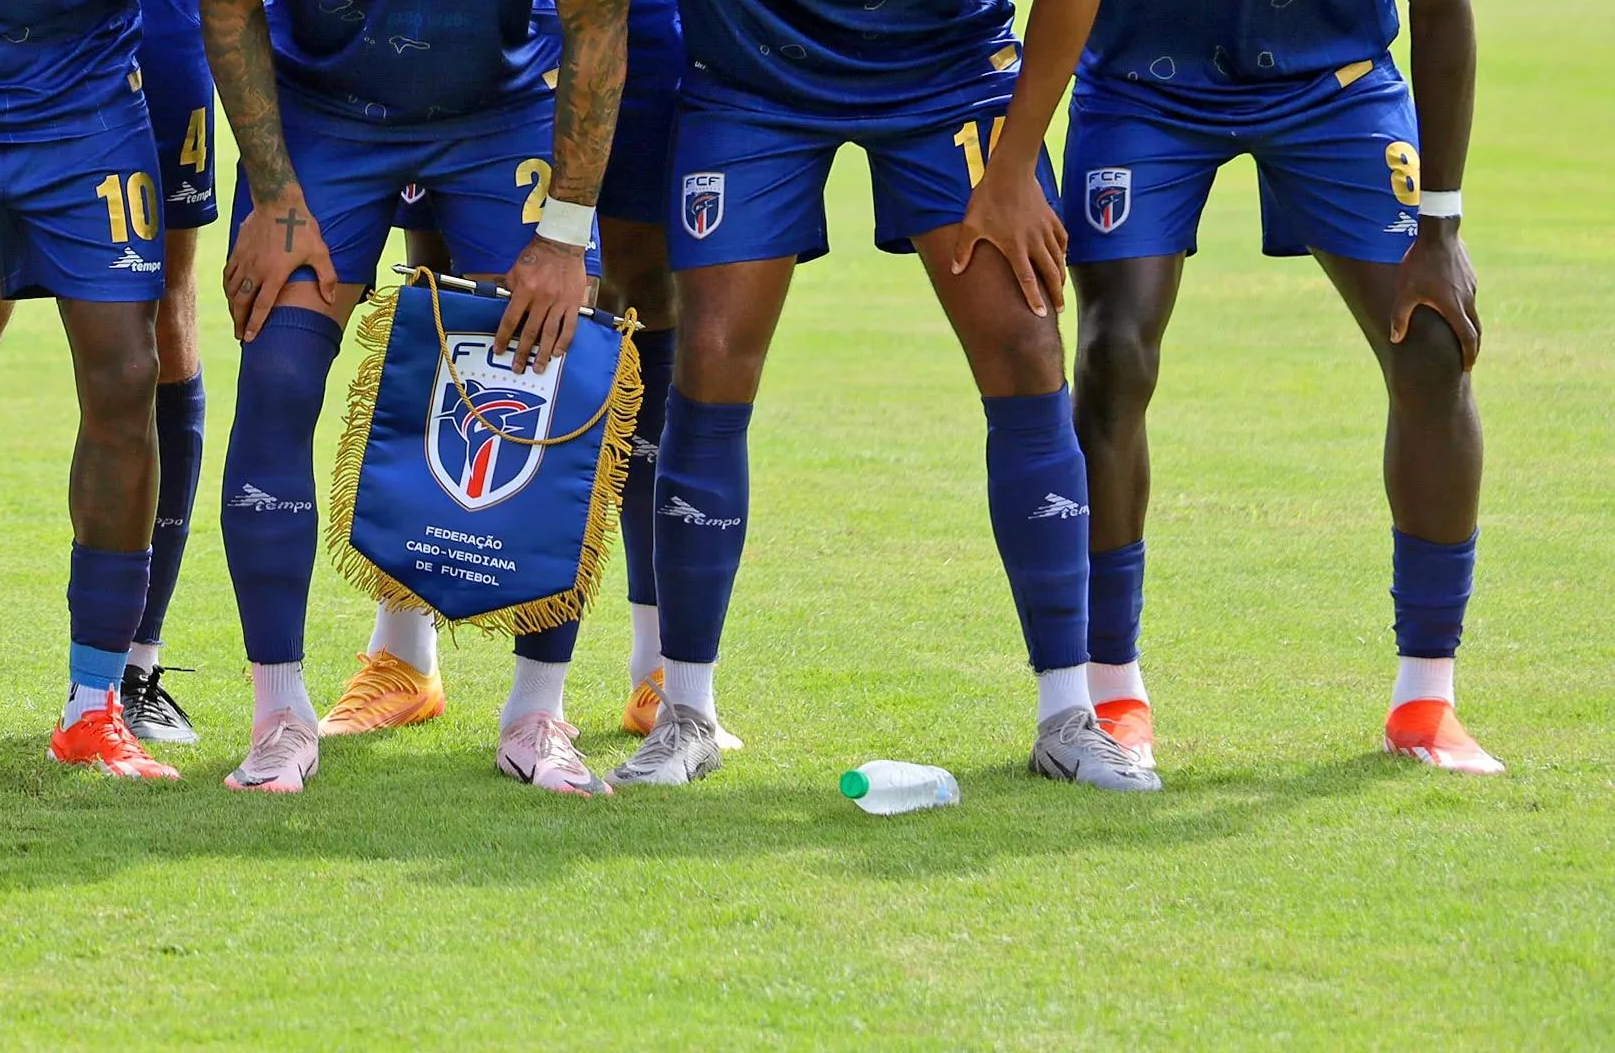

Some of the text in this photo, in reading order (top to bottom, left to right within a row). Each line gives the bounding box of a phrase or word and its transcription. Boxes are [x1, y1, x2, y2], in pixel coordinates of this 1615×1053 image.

[179, 107, 207, 174] 4
[686, 176, 719, 188] FCF
[1089, 171, 1126, 183] FCF
[1385, 141, 1420, 206] 8
[96, 171, 159, 243] 10
[452, 341, 551, 374] FC
[254, 497, 313, 511] tempo
[683, 514, 741, 530] tempo
[425, 525, 502, 550] FEDERAÇÃO
[406, 540, 516, 572] CABO-VERDIANA
[415, 560, 500, 587] DE FUTEBOL
